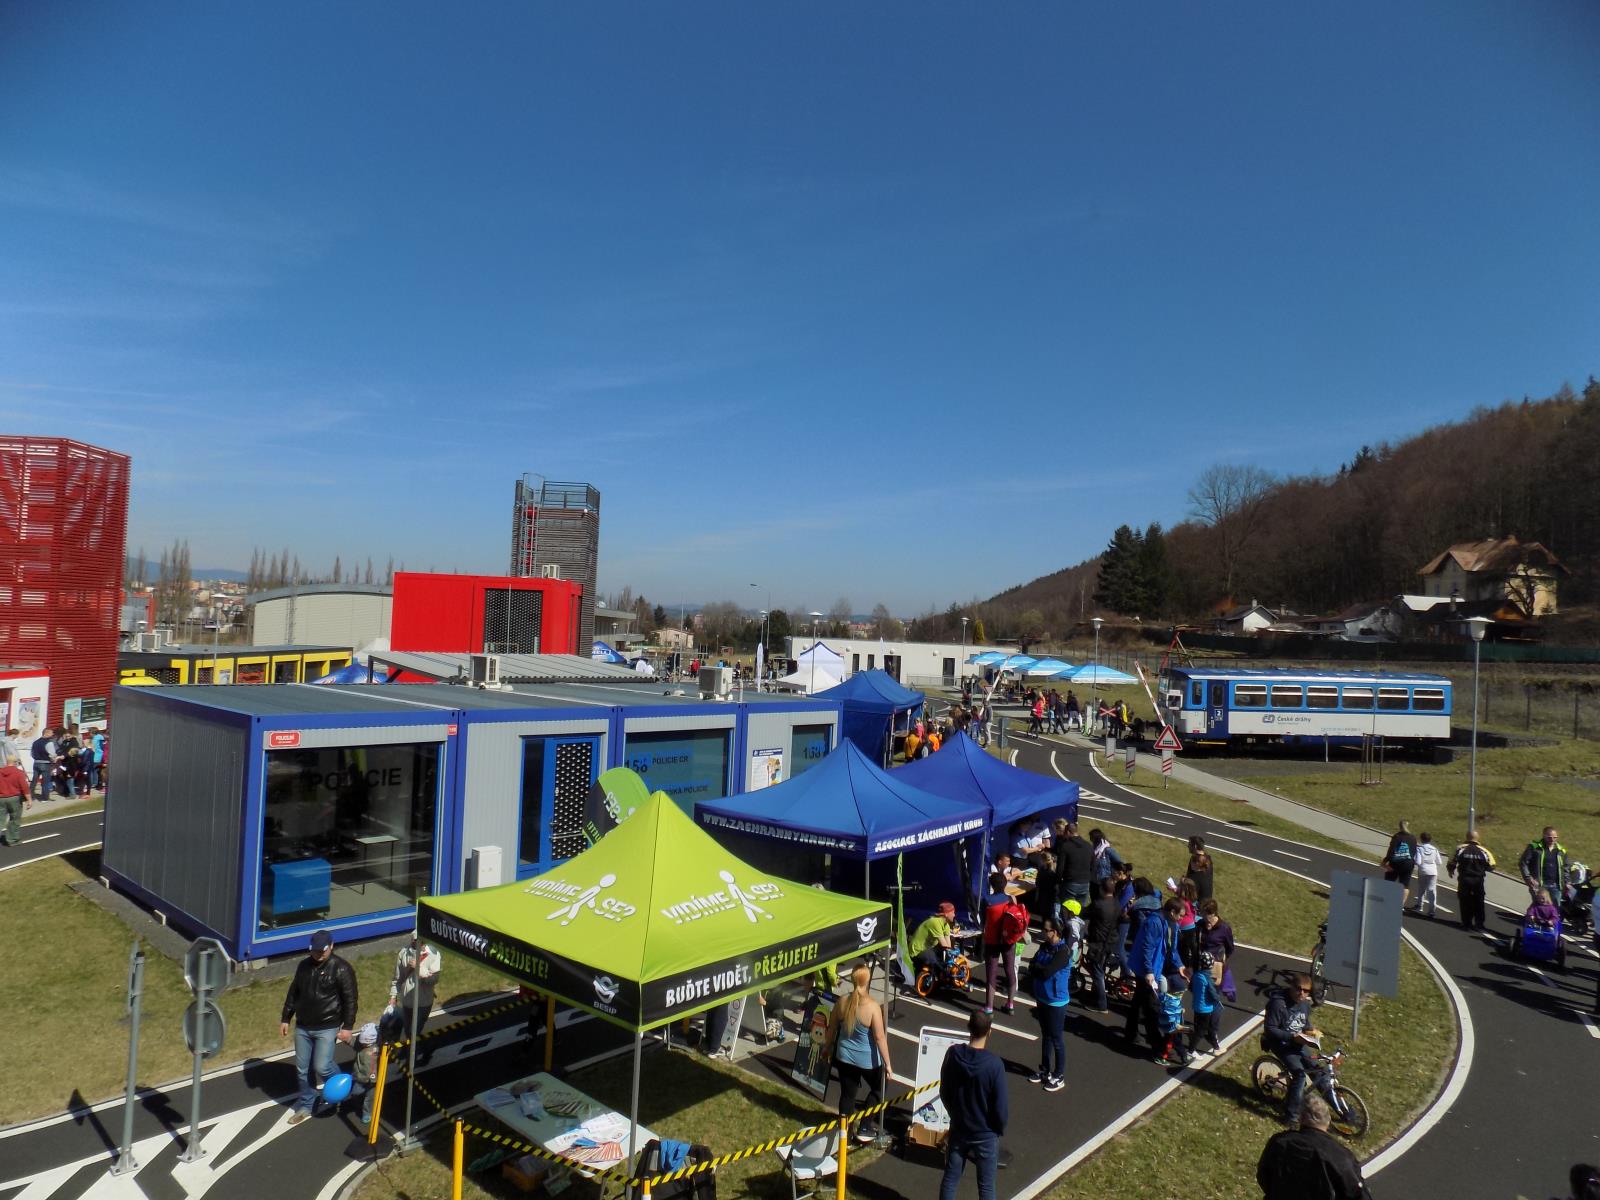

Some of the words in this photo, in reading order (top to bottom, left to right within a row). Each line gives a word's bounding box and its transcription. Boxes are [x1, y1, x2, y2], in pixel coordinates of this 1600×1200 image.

[874, 833, 917, 852] ASOCIACE
[918, 821, 963, 843] ZÁCHRANNÝ
[963, 818, 983, 831] KRUH
[594, 898, 636, 922] SE?
[660, 892, 737, 924] VIDÍME
[750, 883, 785, 900] SE?
[430, 918, 458, 943] BUĎTE
[489, 941, 549, 979] PŘEŽIJETE!
[665, 979, 710, 1008] BUĎTE
[711, 964, 752, 993] VIDĚT,
[753, 942, 818, 979] PŘEŽIJETE!
[594, 1001, 617, 1014] BESIP
